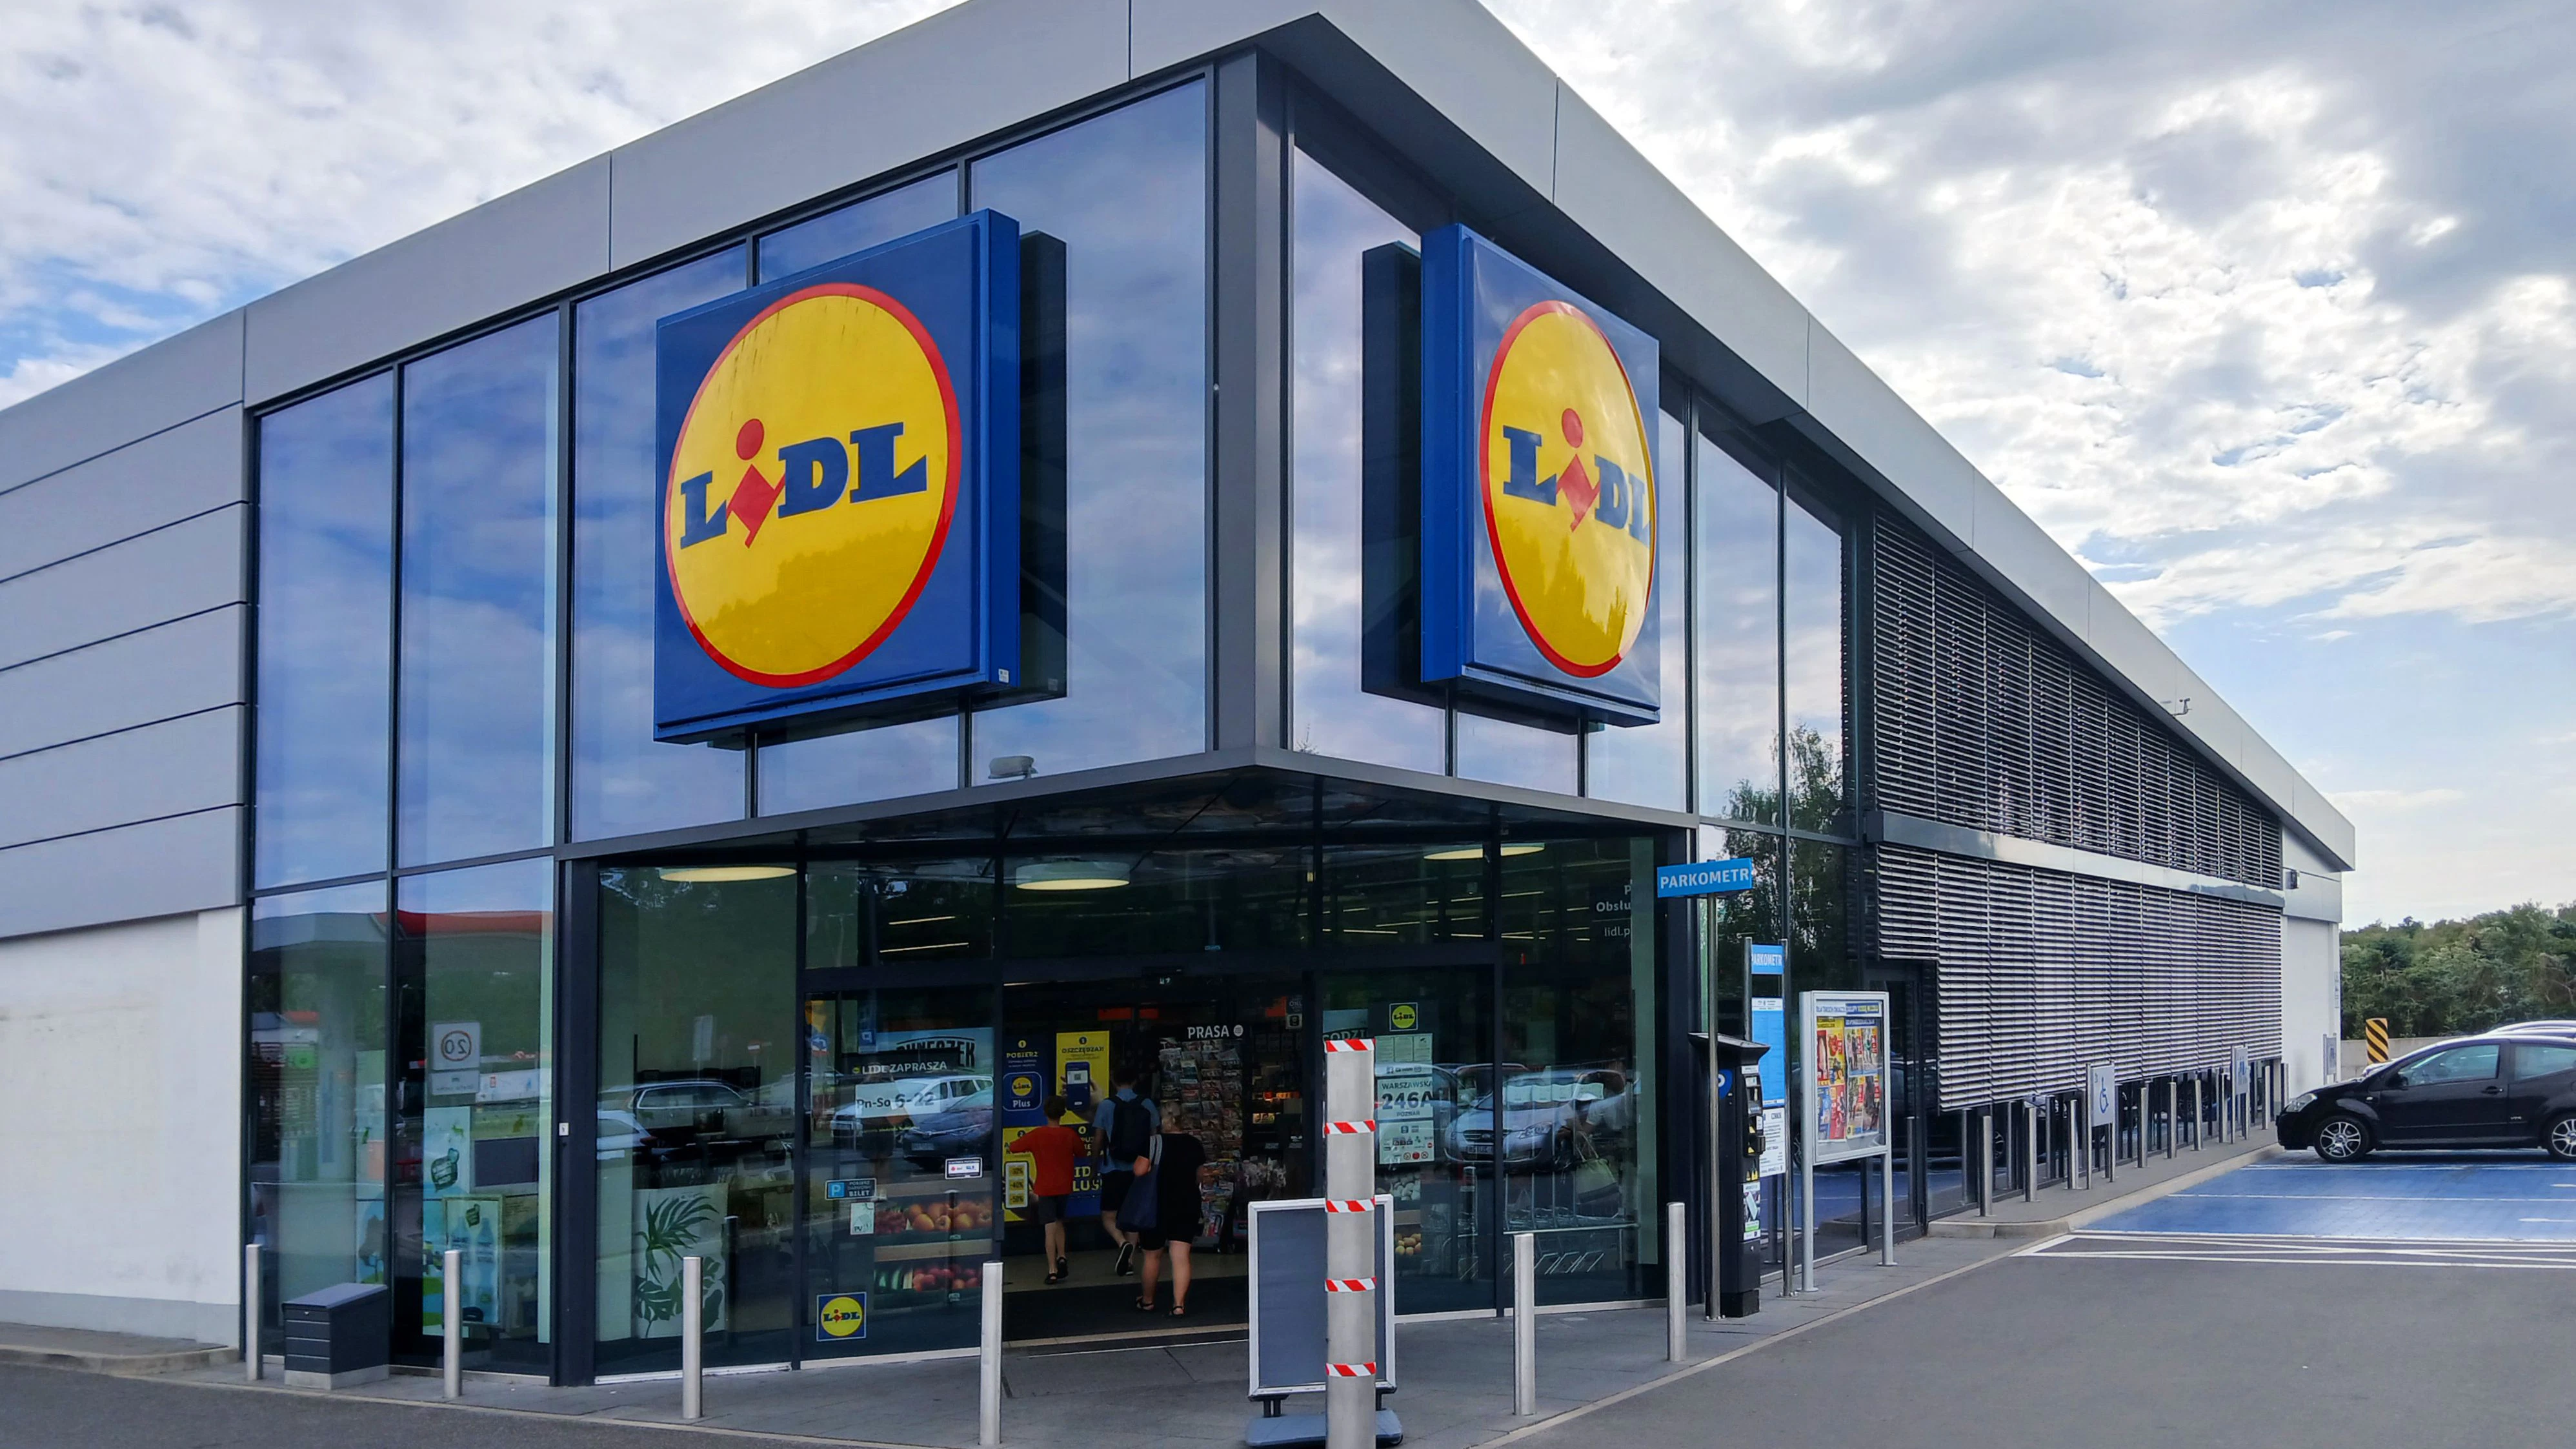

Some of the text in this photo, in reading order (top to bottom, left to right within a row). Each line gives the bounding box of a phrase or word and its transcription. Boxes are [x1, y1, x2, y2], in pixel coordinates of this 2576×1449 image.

[1660, 867, 1749, 889] PARKOMETR
[1596, 900, 1631, 912] Obsłu
[1604, 926, 1631, 938] lidl.p
[1187, 1025, 1229, 1039] PRASA
[889, 1060, 947, 1073] ZAPRASZA
[1382, 1080, 1433, 1090] WARSZAWSKA
[1012, 1100, 1031, 1108] Plus
[1382, 1090, 1433, 1110] 246A
[831, 1184, 841, 1197] P
[1072, 1179, 1103, 1192] LUS!
